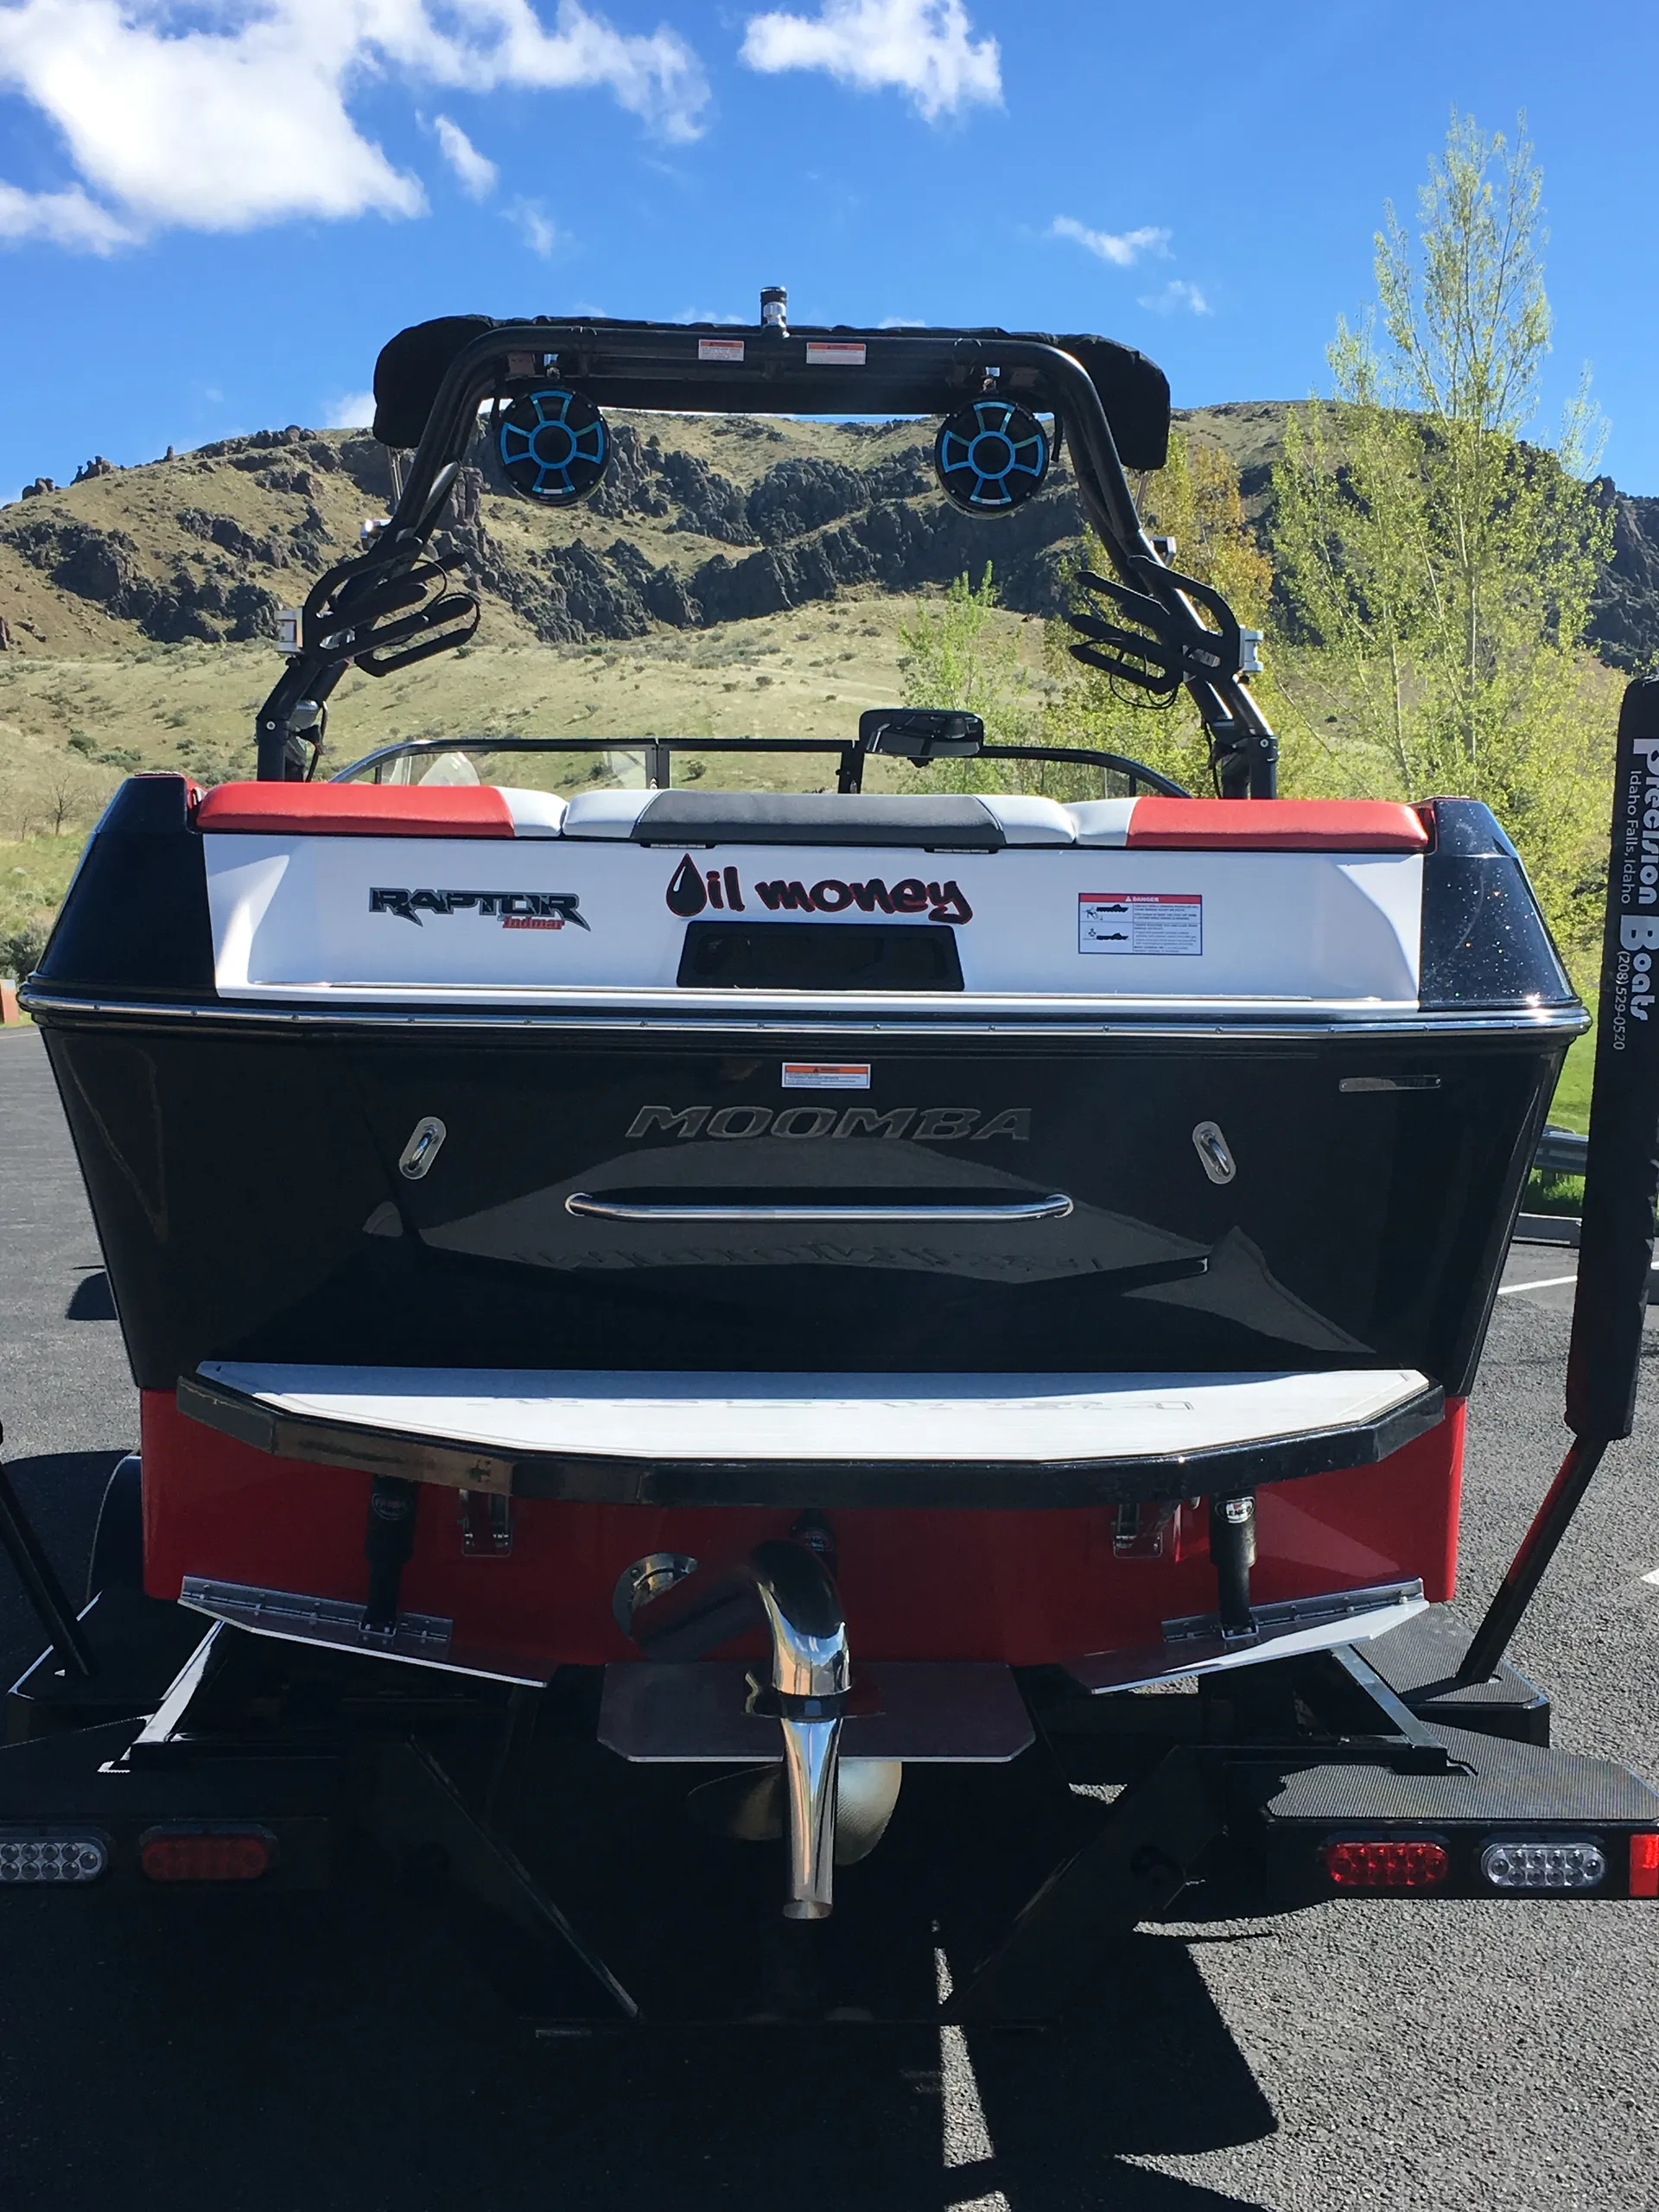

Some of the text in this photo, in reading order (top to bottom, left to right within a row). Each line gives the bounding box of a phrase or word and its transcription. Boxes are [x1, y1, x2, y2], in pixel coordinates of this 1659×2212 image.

[1621, 771, 1642, 904] Idaho Falls, Idaho
[370, 887, 591, 931] RAPTOR
[754, 878, 973, 925] money
[1620, 739, 1659, 1020] Precision Boats
[1613, 950, 1630, 1051] (208) 529-0520
[625, 1106, 1032, 1141] MOOMBA
